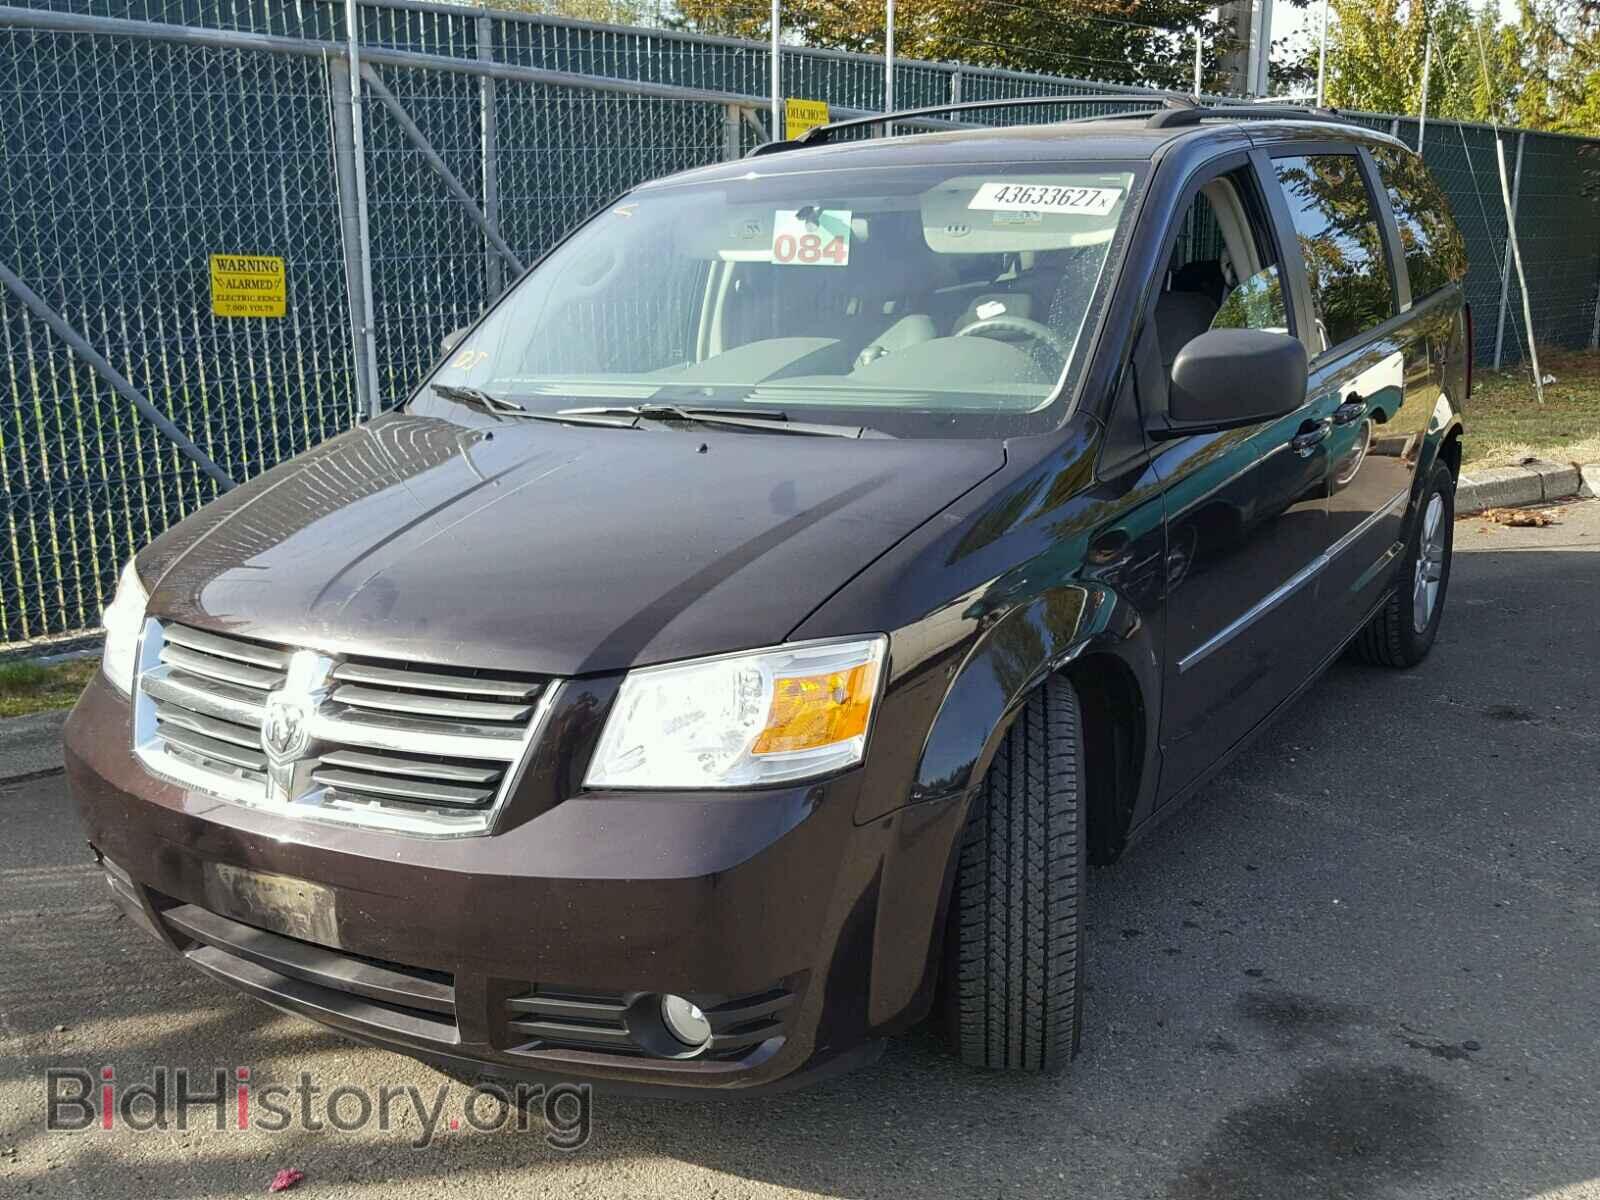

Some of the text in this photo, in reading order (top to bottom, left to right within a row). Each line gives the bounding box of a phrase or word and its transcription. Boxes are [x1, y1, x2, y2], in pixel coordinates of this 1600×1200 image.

[994, 186, 1102, 207] 43633627
[774, 234, 847, 263] 084
[216, 258, 279, 273] WARNING
[226, 279, 273, 290] ALARMED
